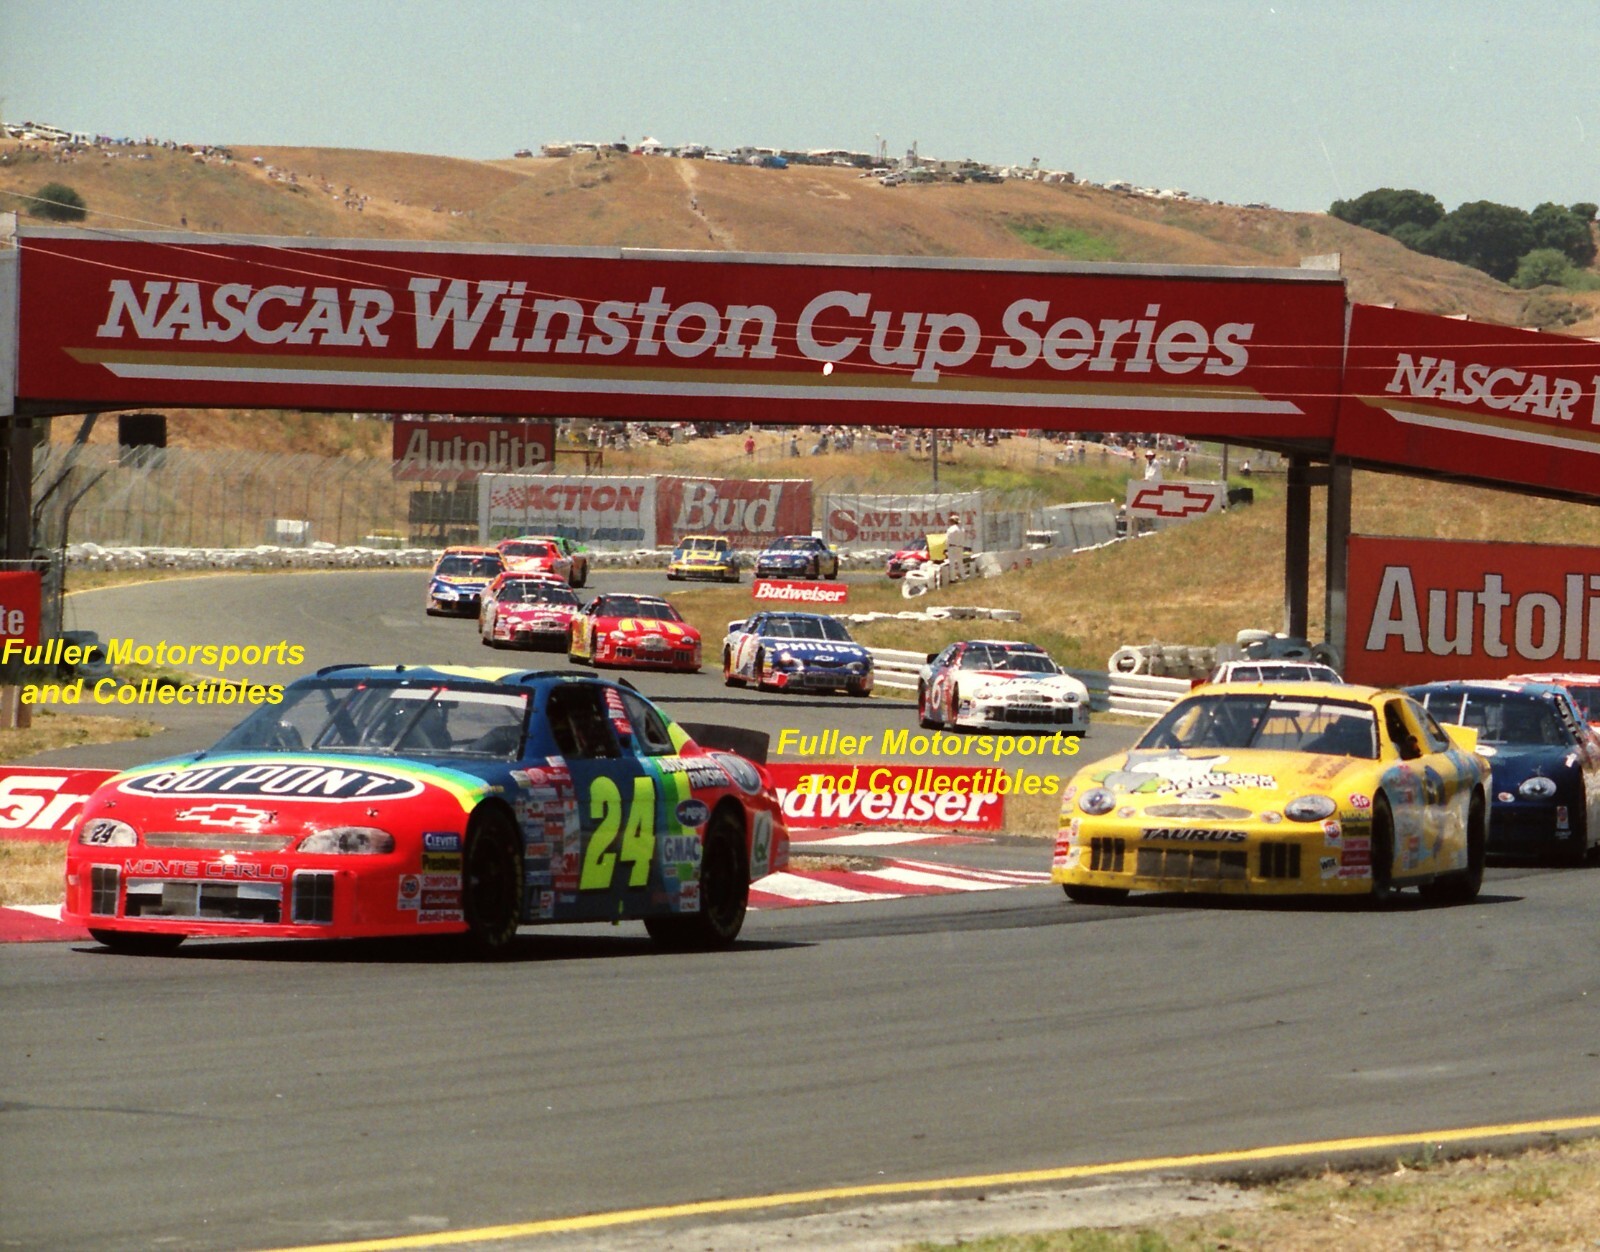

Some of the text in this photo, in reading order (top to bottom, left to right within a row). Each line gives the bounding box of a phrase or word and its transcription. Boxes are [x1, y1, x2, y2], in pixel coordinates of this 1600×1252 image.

[97, 278, 1255, 383] NASCAR Winston Cup Series
[1385, 352, 1582, 421] NASCAR
[402, 427, 546, 472] Autolite
[522, 484, 645, 512] ACTION
[675, 482, 782, 532] Bud
[755, 582, 846, 602] Budweiser
[774, 642, 864, 656] PHILIPS
[91, 823, 117, 844] 24
[579, 776, 656, 890] 24
[1142, 828, 1248, 842] TAURUS
[664, 836, 700, 862] GMAC
[124, 858, 289, 880] MONTE CARLO
